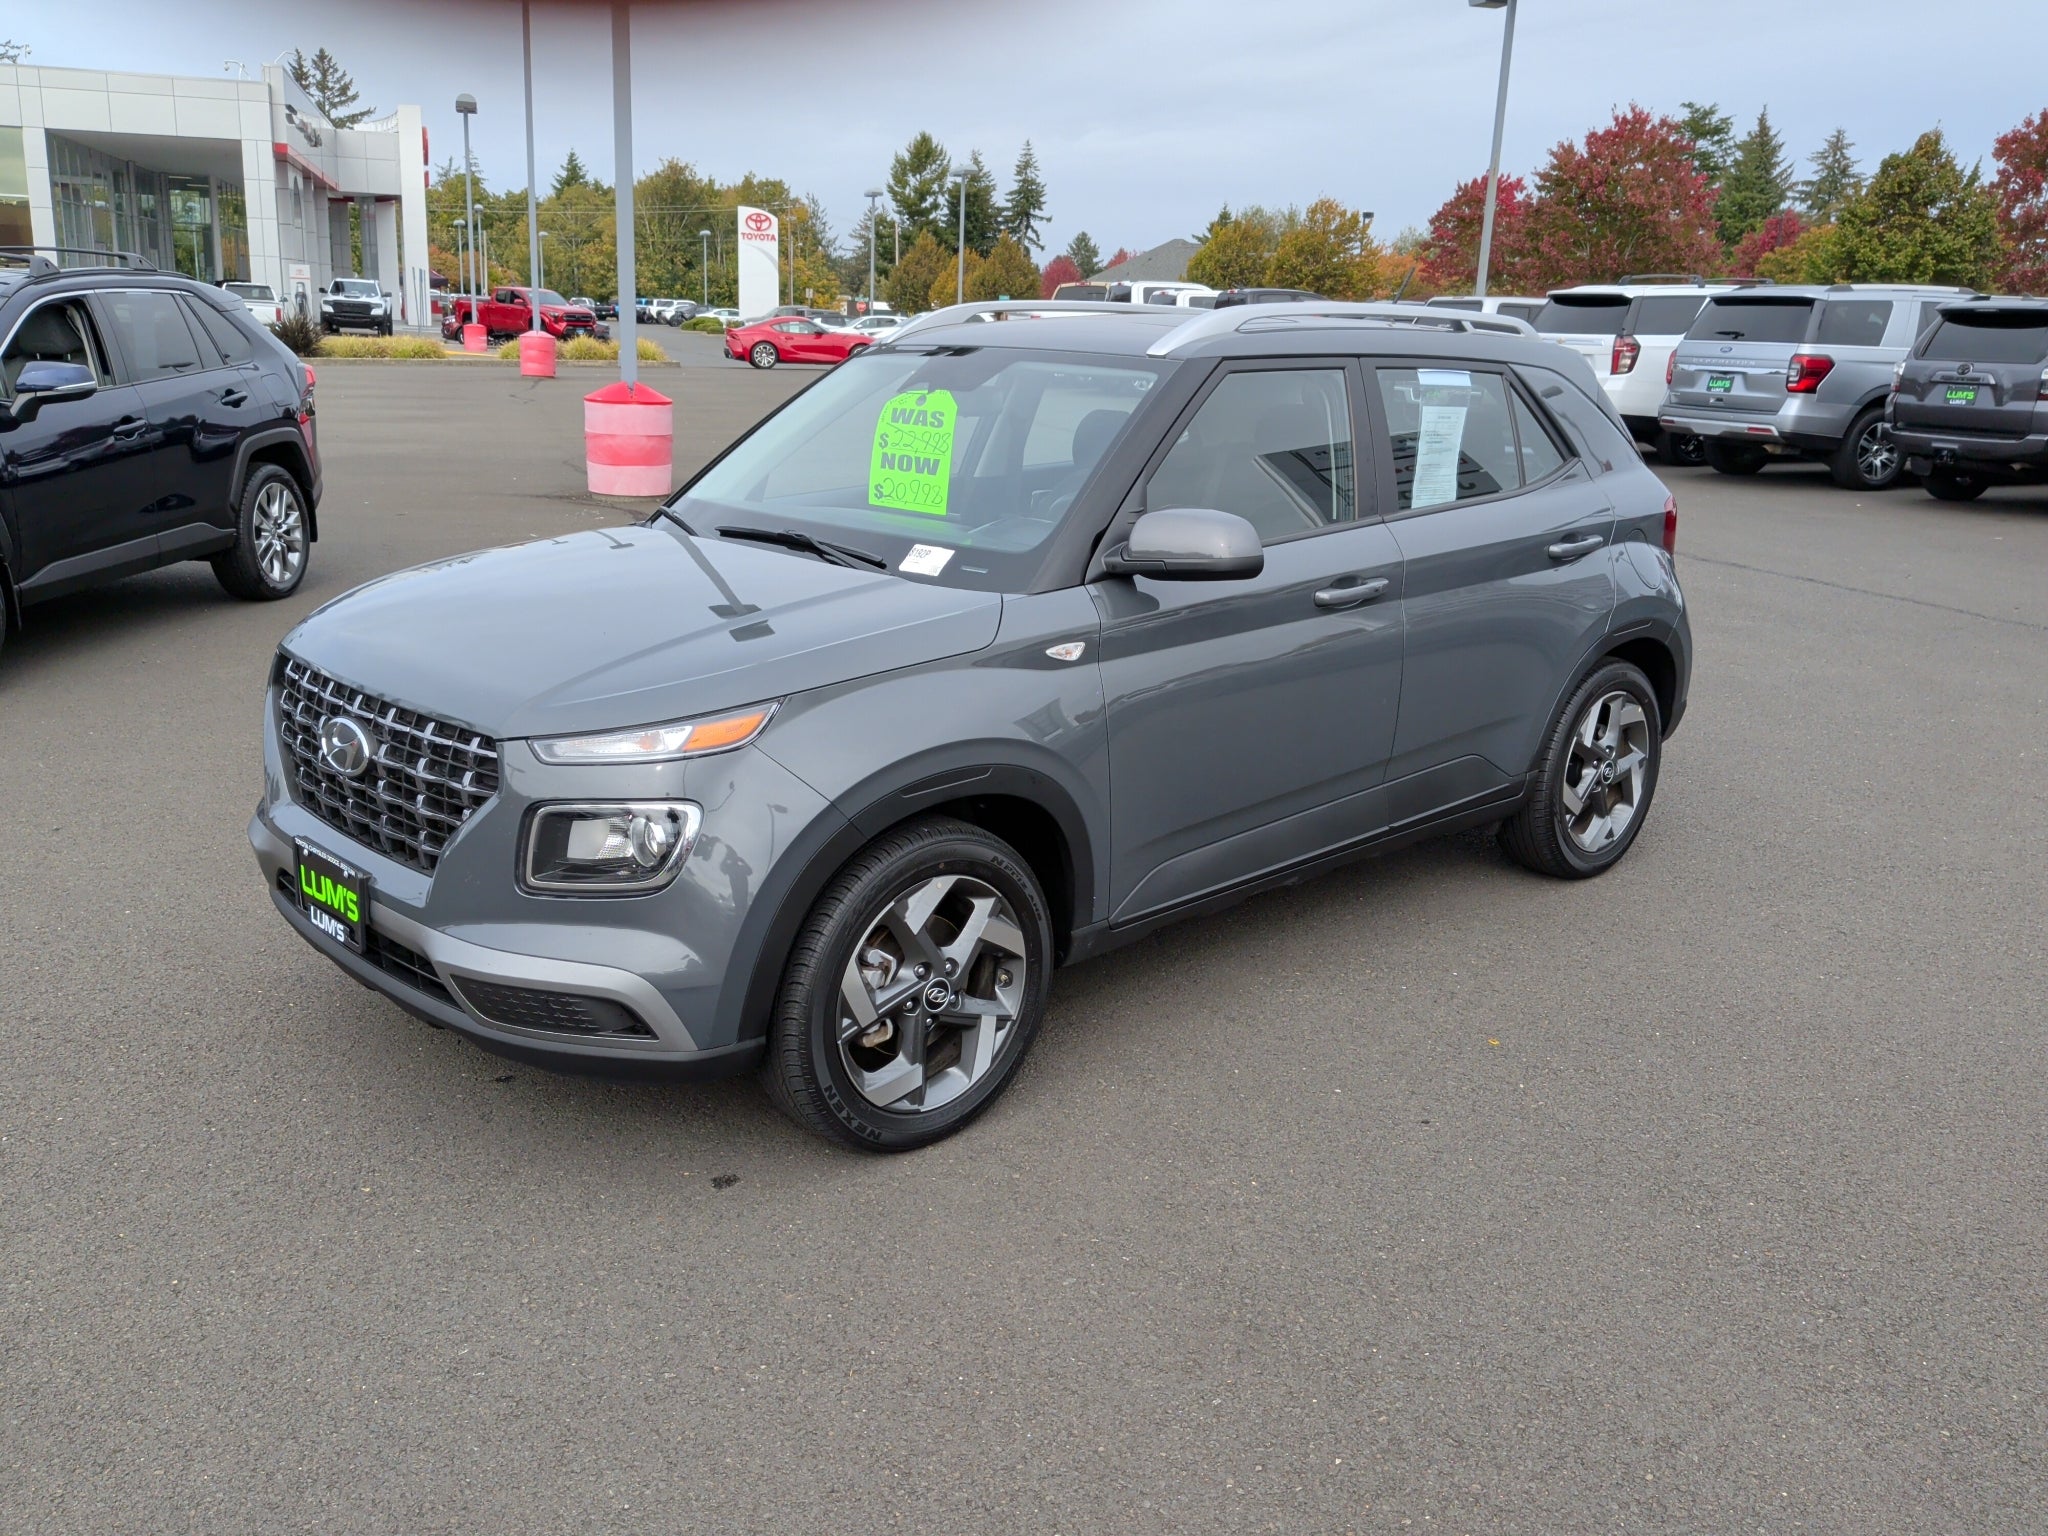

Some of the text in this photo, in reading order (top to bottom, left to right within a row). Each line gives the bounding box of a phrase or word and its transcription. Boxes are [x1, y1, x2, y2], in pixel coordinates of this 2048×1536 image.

[741, 232, 776, 242] TOYOTA
[1709, 379, 1731, 388] LUM'S
[1946, 390, 1975, 400] LUM'S
[890, 407, 945, 429] WAS
[880, 452, 941, 476] NOW
[300, 864, 359, 922] LUM'S
[310, 905, 345, 942] LUM'S
[823, 1084, 883, 1141] NEXEN
